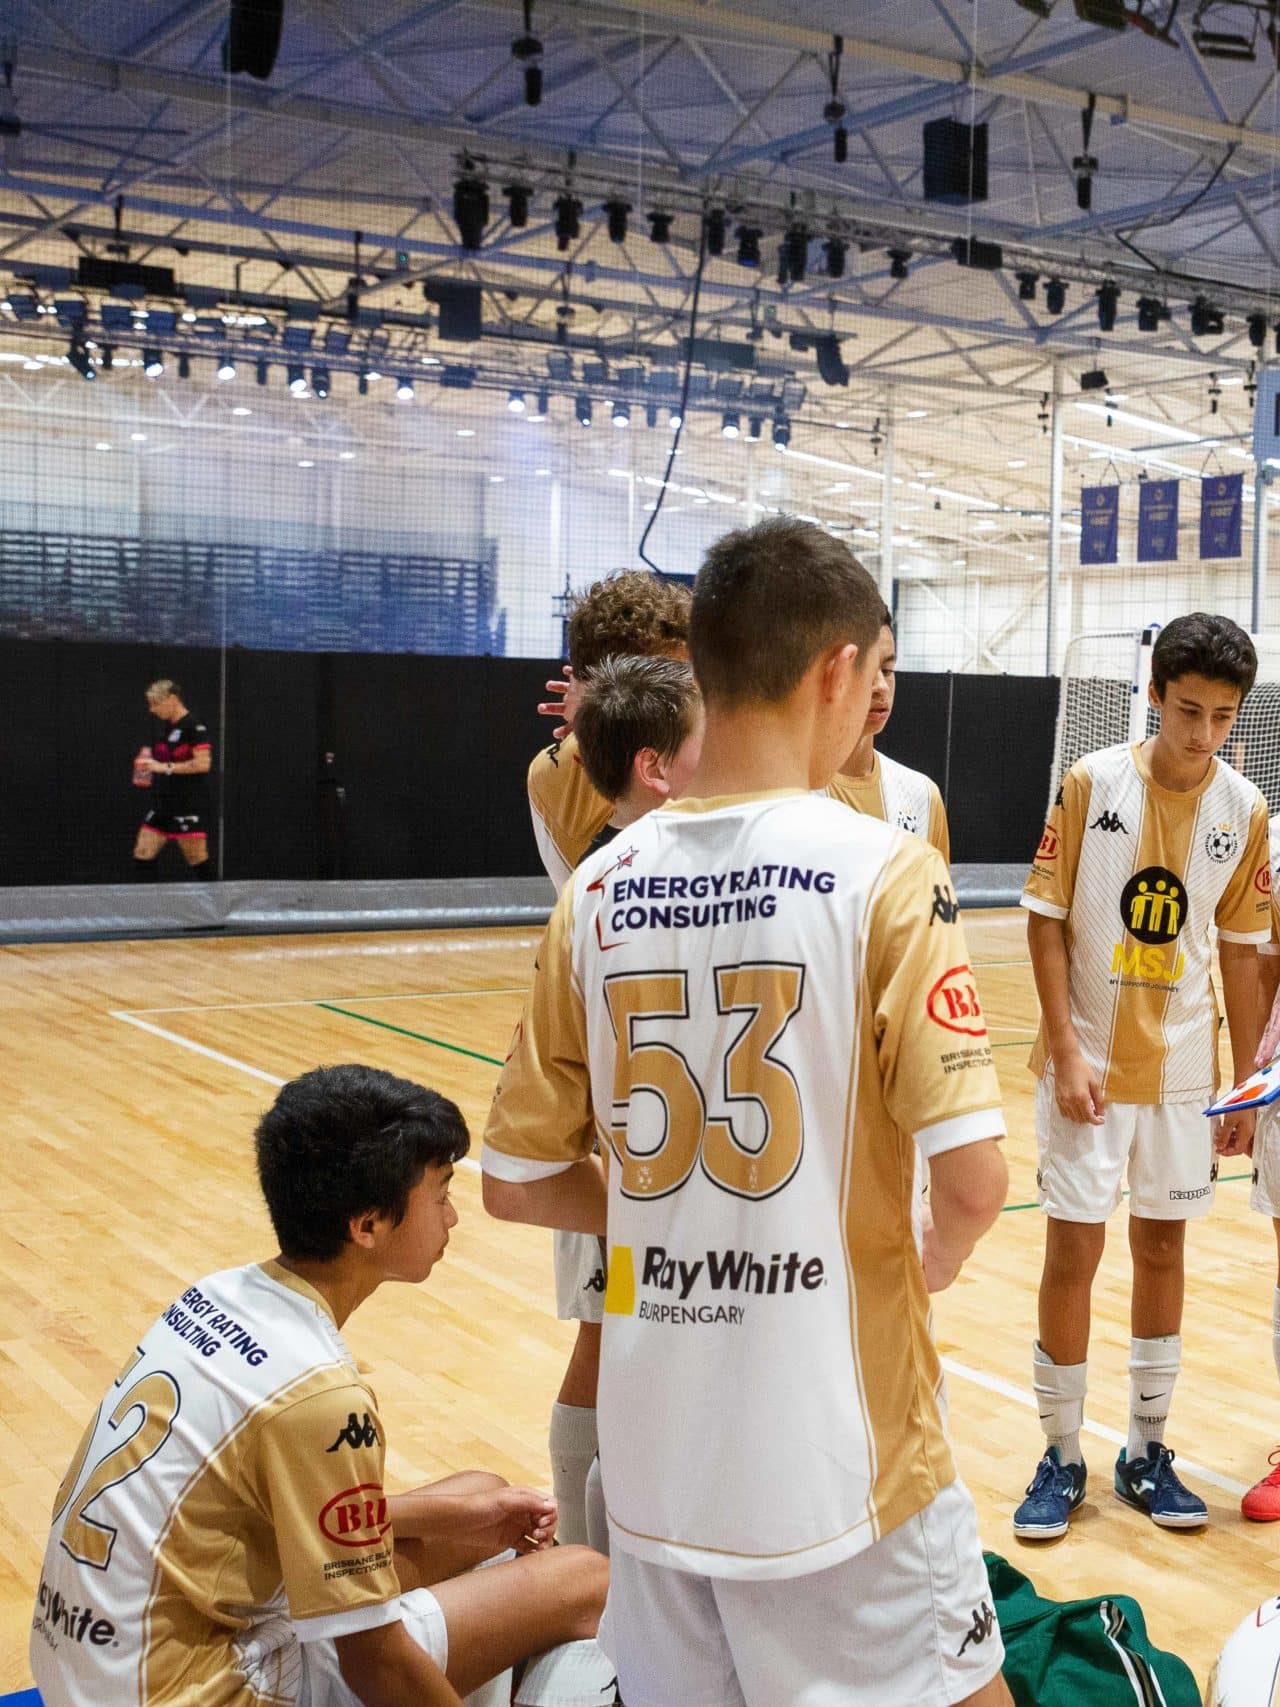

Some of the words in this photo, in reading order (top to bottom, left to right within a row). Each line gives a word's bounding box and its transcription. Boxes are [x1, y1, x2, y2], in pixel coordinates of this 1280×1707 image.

[613, 874, 727, 904] ENERGY
[729, 864, 836, 894] RATING
[1110, 943, 1185, 981] MSJ
[602, 960, 807, 1202] 53
[1169, 1186, 1210, 1201] Kappa
[639, 1300, 745, 1326] BURPENGARY
[207, 1313, 268, 1367] RATING
